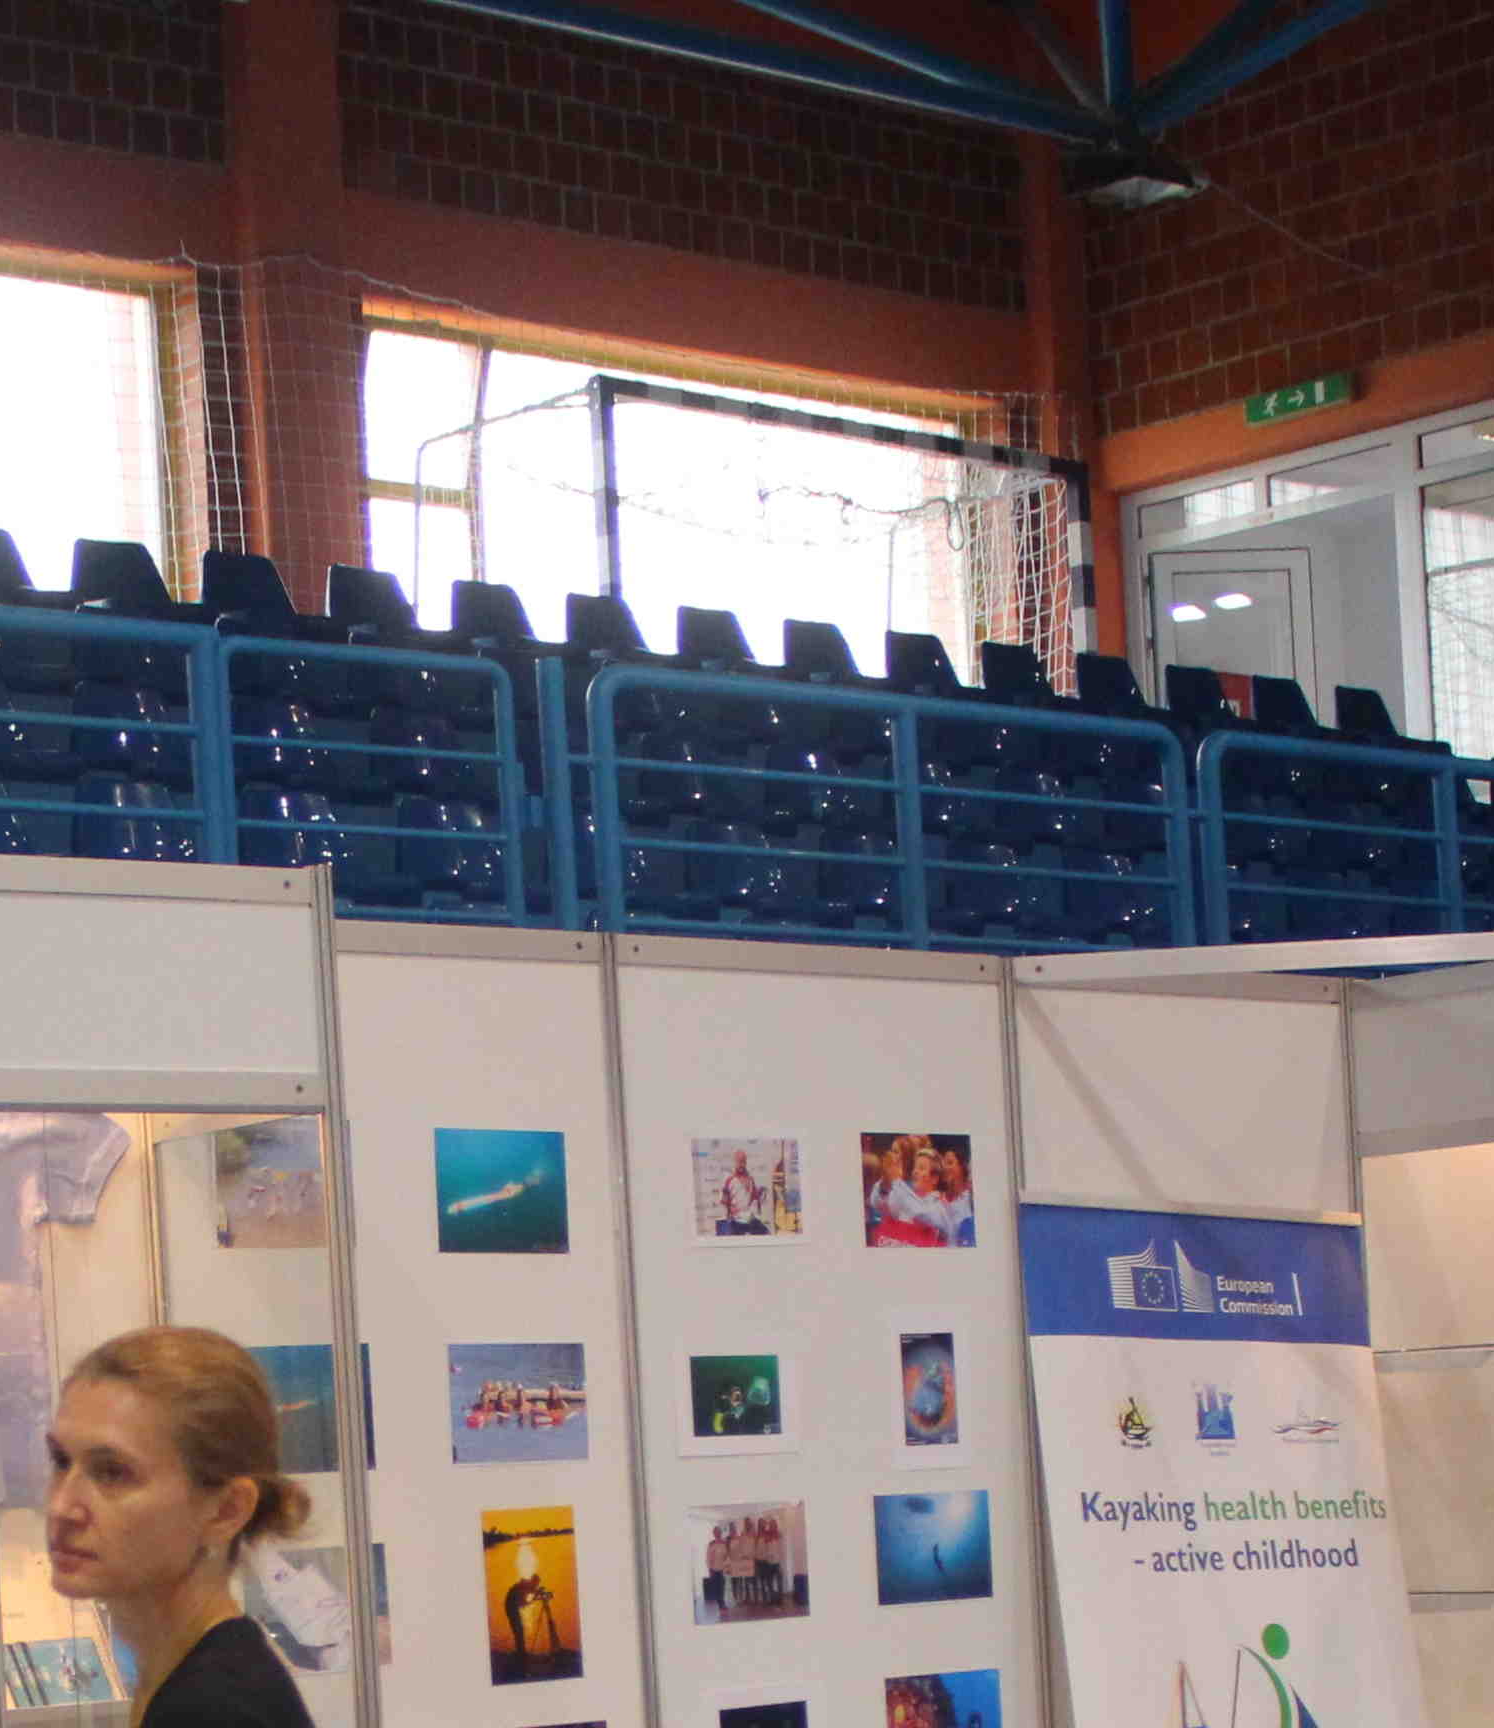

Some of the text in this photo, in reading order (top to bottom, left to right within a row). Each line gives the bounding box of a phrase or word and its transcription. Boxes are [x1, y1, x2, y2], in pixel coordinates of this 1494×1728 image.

[1216, 1275, 1275, 1296] European
[1219, 1297, 1294, 1316] Commission
[1080, 1490, 1387, 1532] Kayaking health benefits
[1152, 1543, 1224, 1573] active
[1232, 1538, 1360, 1571] childhood
